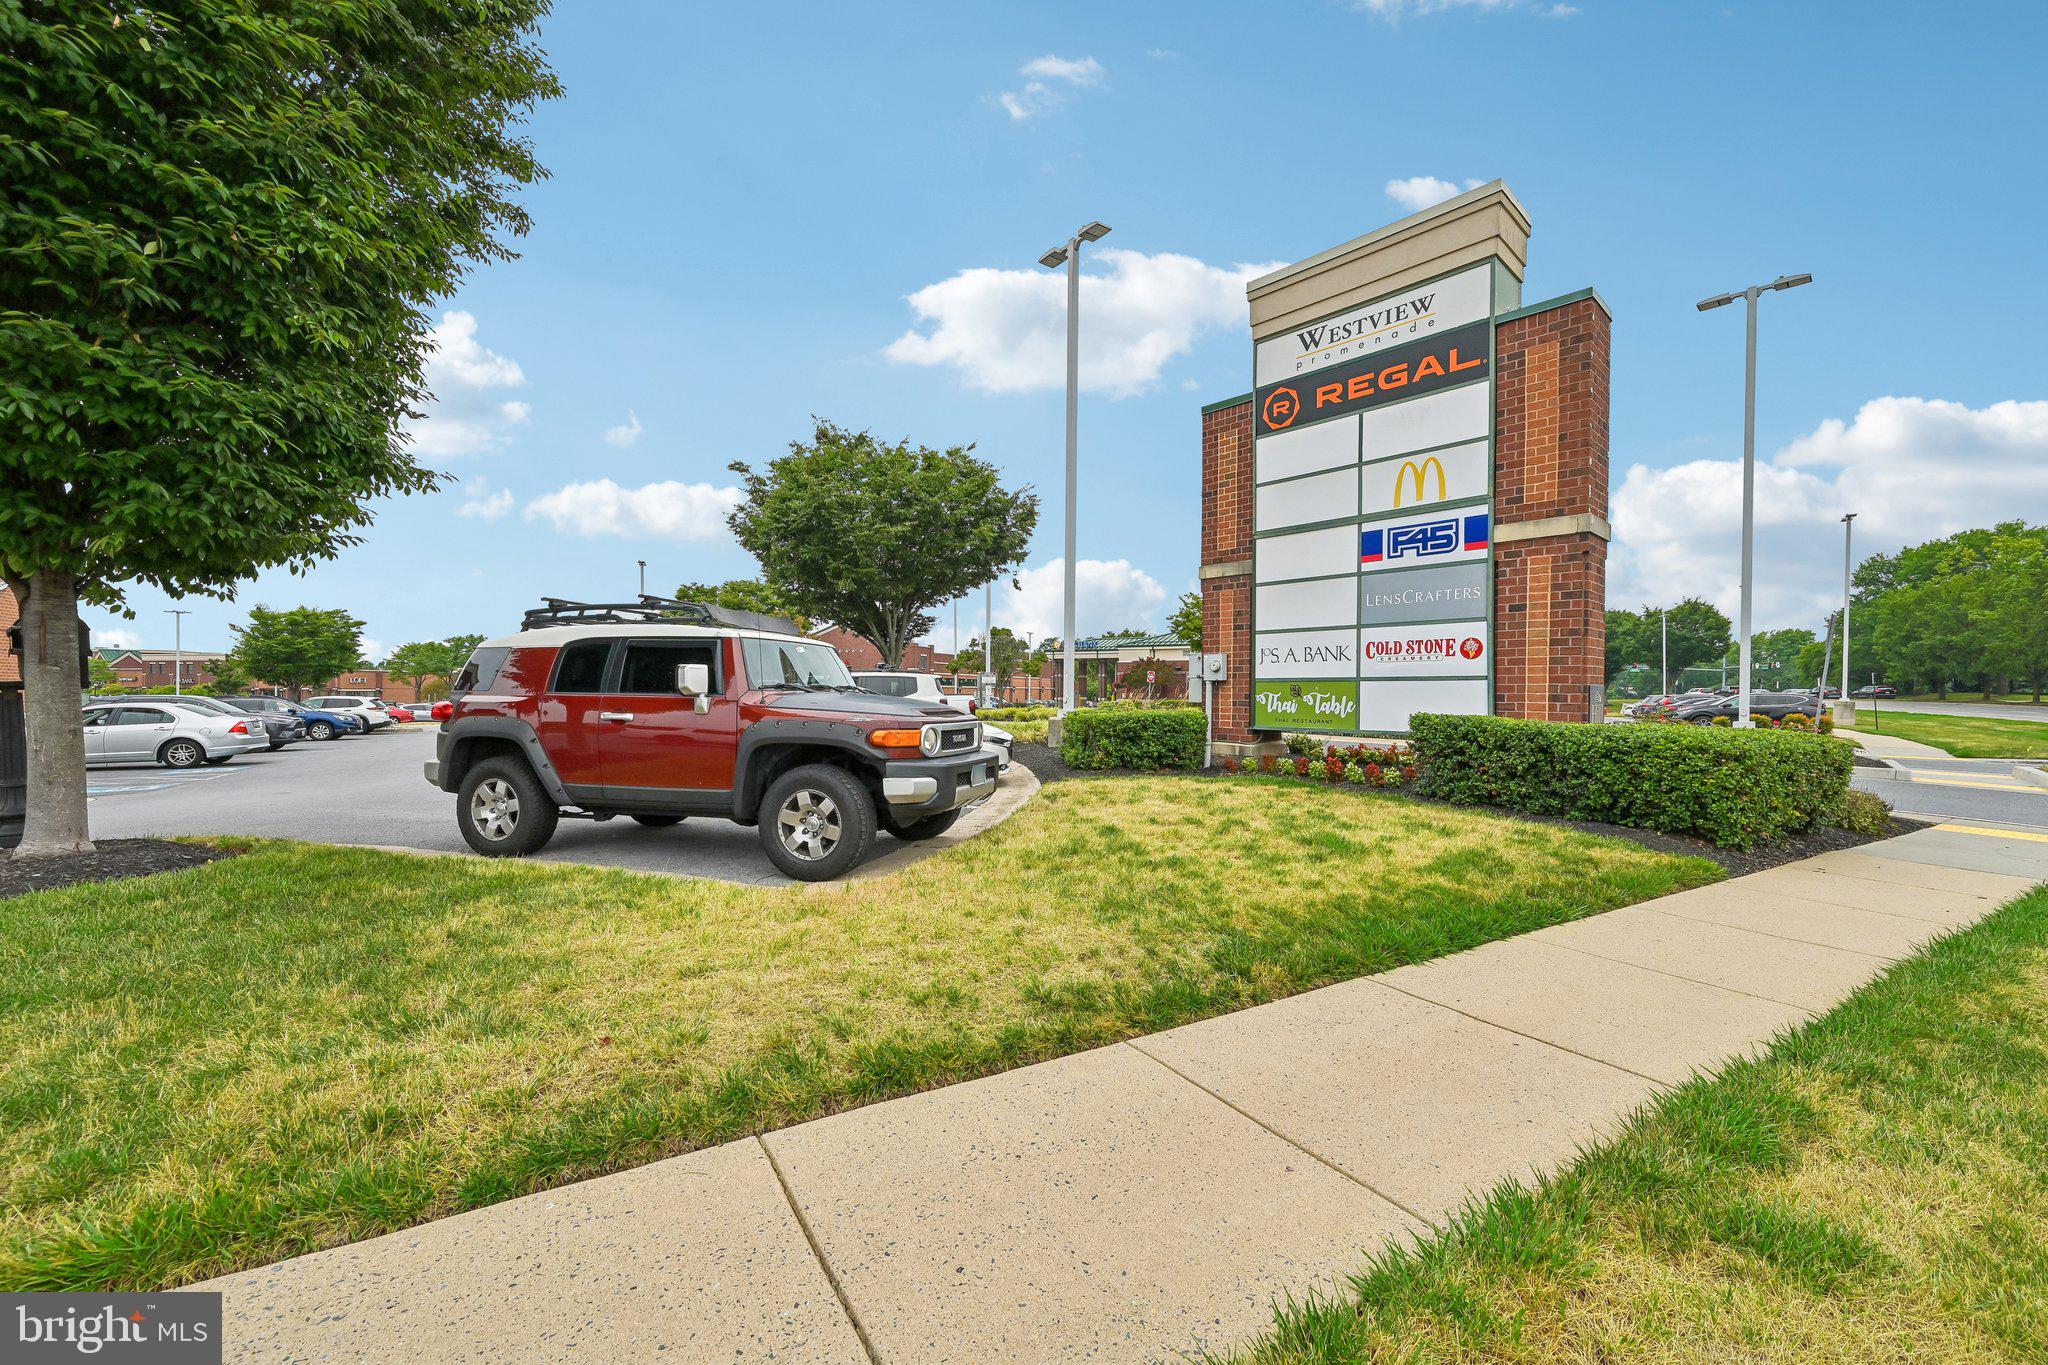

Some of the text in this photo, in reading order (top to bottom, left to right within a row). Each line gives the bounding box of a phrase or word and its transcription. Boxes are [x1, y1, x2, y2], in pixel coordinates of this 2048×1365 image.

[1297, 293, 1436, 352] WESTVIEW
[1296, 318, 1435, 371] promenade
[1316, 348, 1482, 409] REGAL
[1387, 518, 1460, 560] F45
[1283, 647, 1301, 663] A.
[1303, 644, 1352, 663] BANK
[1366, 637, 1457, 659] COLD STONE
[1254, 692, 1357, 719] Thai Table
